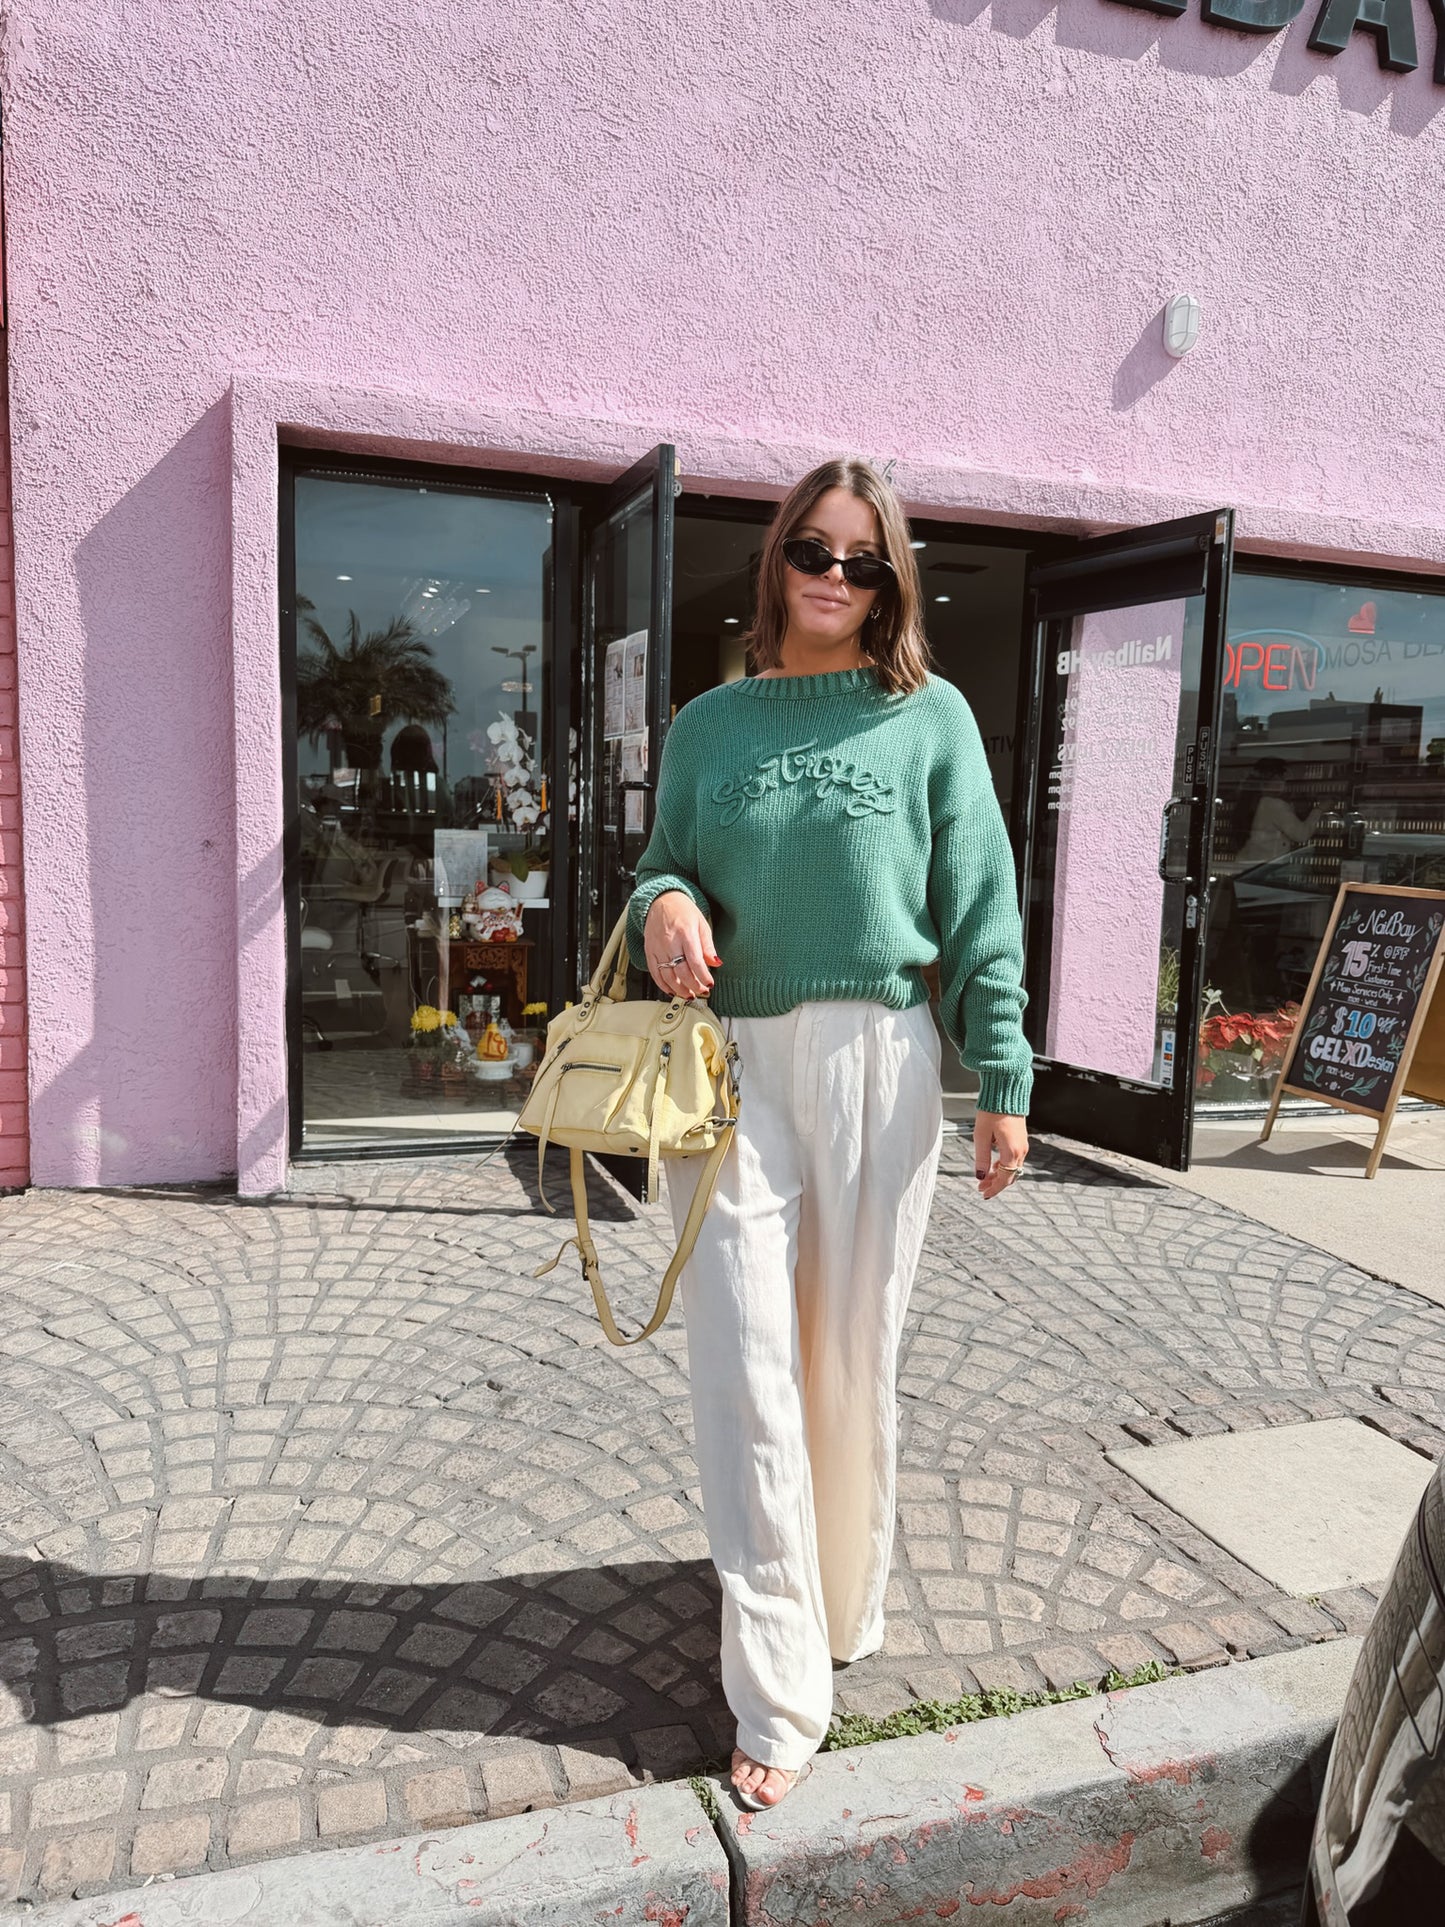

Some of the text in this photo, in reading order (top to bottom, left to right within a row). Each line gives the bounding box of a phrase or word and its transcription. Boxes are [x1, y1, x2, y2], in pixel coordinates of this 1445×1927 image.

[1199, 731, 1208, 770] PUSH
[1185, 746, 1194, 782] PUSH
[1383, 945, 1410, 960] OFF
[1364, 973, 1395, 987] Customers
[1351, 984, 1379, 998] Services
[1377, 988, 1396, 1005] Only
